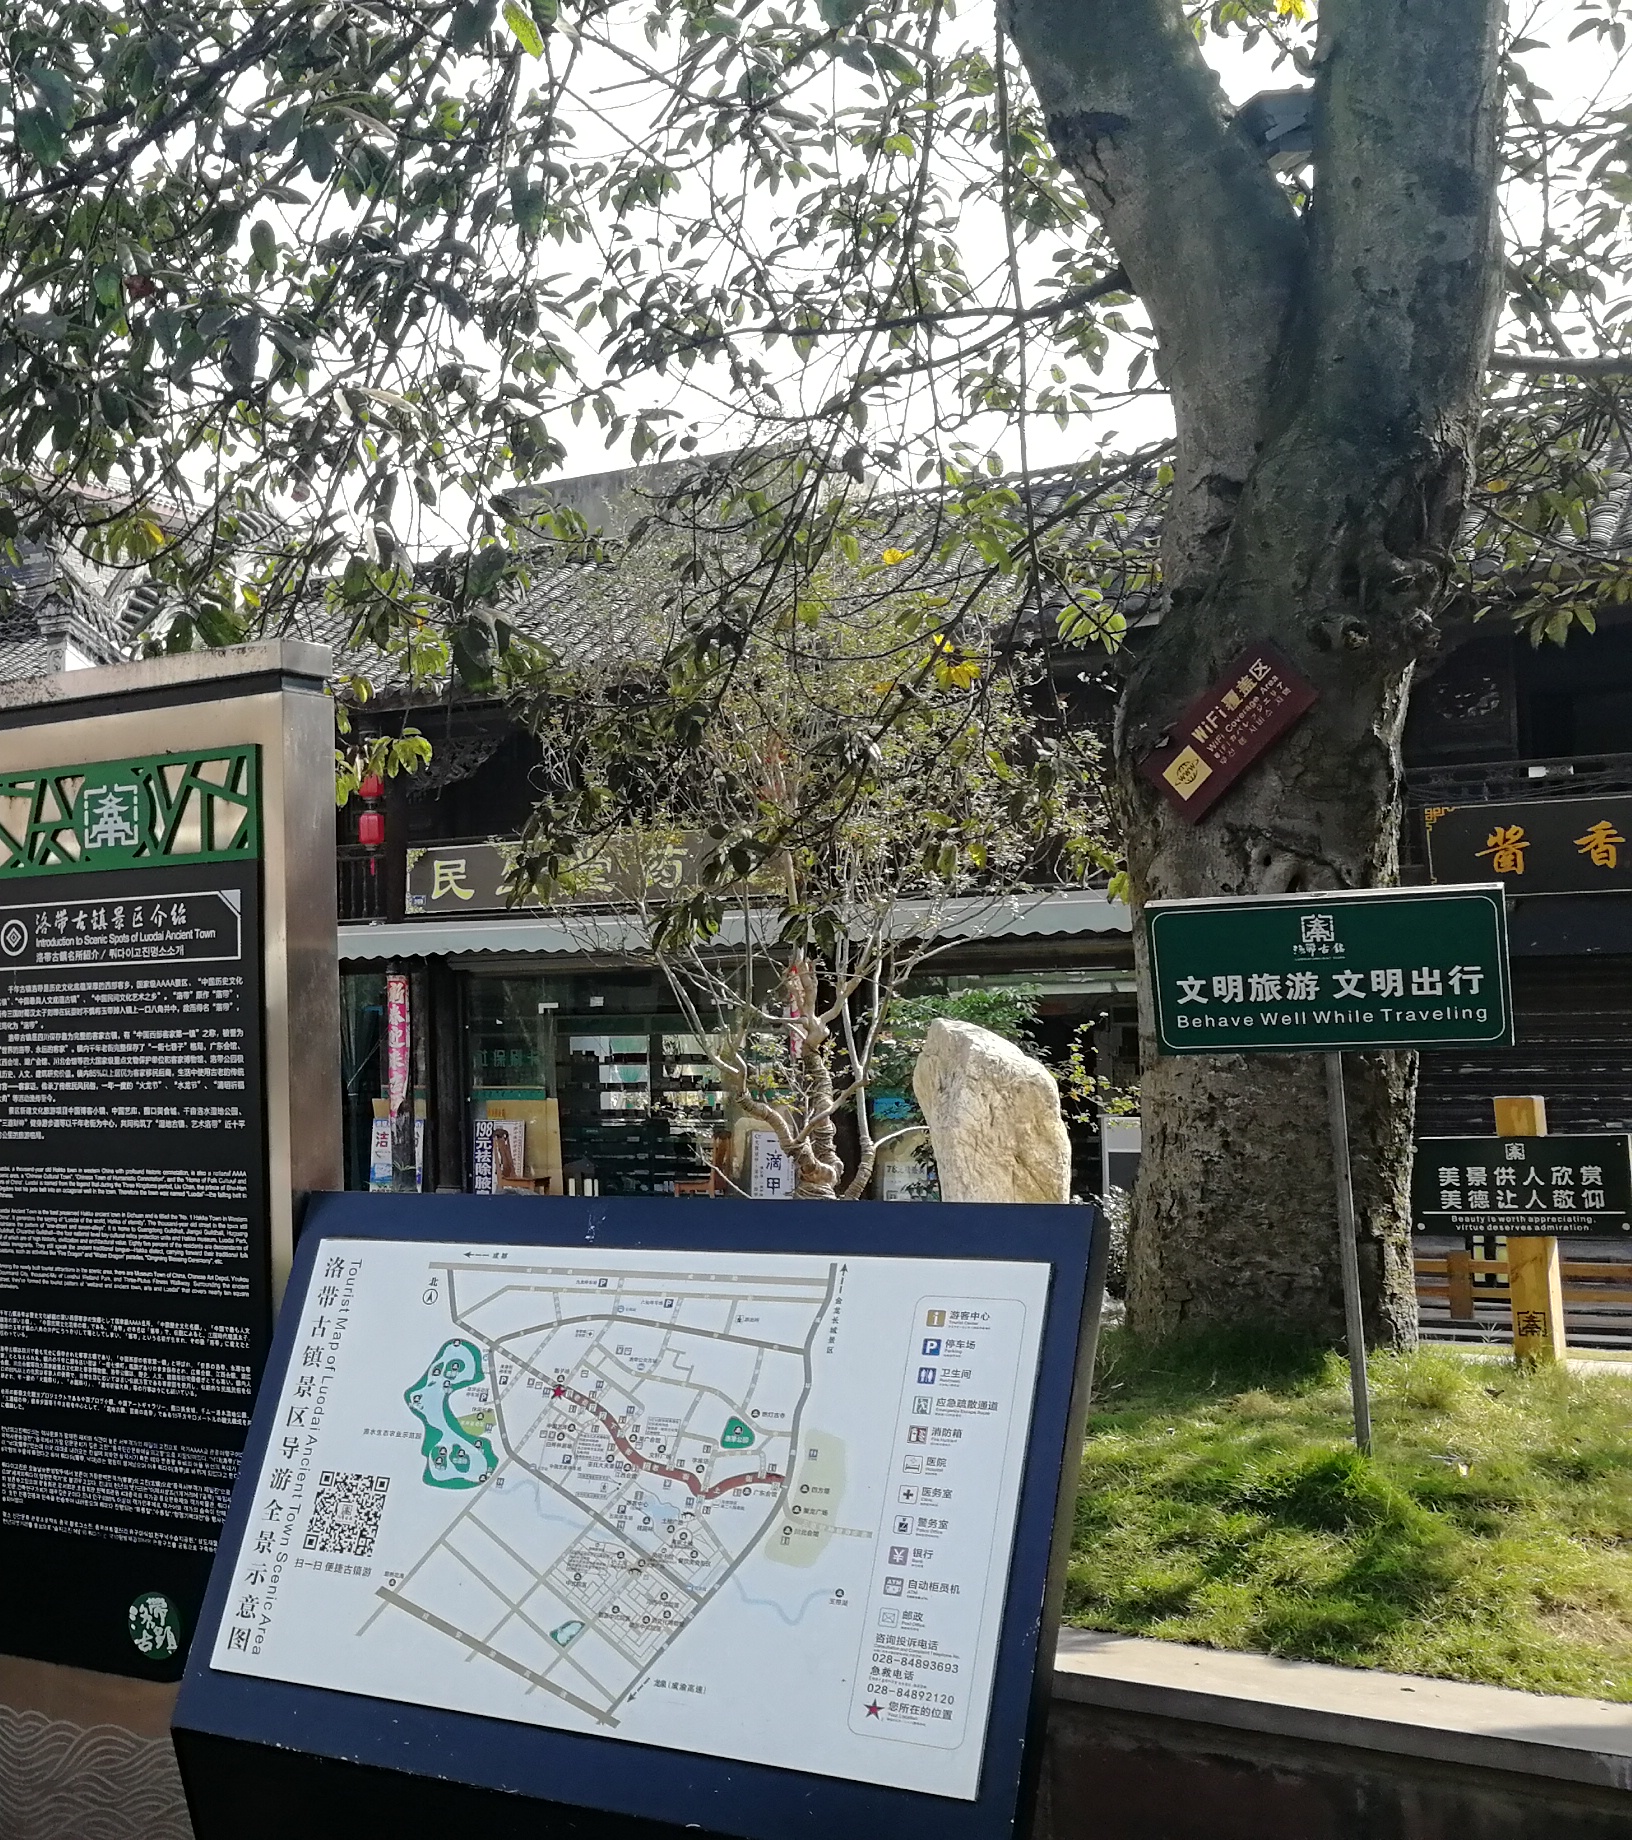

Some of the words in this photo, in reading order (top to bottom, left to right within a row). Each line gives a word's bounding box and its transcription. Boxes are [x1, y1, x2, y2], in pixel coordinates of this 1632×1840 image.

[1224, 695, 1260, 733] Coverage
[1259, 674, 1279, 695] Area
[35, 902, 187, 935] 洛带古镇景区介绍
[36, 936, 75, 948] Introduction
[84, 934, 108, 946] Scenic
[108, 933, 130, 945] Spots
[139, 931, 164, 943] Luodai
[165, 929, 193, 941] Ancient
[194, 928, 216, 939] Town
[1176, 971, 1320, 1005] 文明旅游
[1332, 965, 1485, 1000] 文明出行
[1177, 1014, 1255, 1030] Behave
[1260, 1011, 1307, 1026] Well
[1313, 1009, 1375, 1025] While
[1380, 1006, 1489, 1024] Traveling
[474, 1121, 494, 1195] 198元祛除腋
[1438, 1165, 1603, 1187] 美景供人欣赏
[1440, 1189, 1606, 1210] 美德让人敬仰
[1451, 1215, 1485, 1224] Beauty
[1487, 1215, 1497, 1223] is
[1498, 1215, 1526, 1223] worth
[1456, 1223, 1485, 1232] virtue
[1487, 1224, 1533, 1232] deserves
[338, 1258, 362, 1313] Tourist
[429, 1277, 438, 1287] 北
[949, 1311, 990, 1322] 游客中心
[328, 1317, 349, 1351] Map
[945, 1339, 976, 1350] 停车场
[324, 1355, 336, 1372] of
[940, 1368, 972, 1379] 卫生间
[310, 1375, 334, 1431] Luodai
[936, 1397, 998, 1412] 应急疏散通道
[931, 1427, 963, 1438] 消防箱
[227, 1256, 345, 1651] 洛带古镇景区导游全景示意图
[926, 1457, 947, 1467] 医院
[292, 1434, 319, 1499] Ancient
[921, 1486, 953, 1499] 医务室
[279, 1503, 302, 1546] Town
[918, 1517, 949, 1530] 警务室
[912, 1548, 934, 1560] 银行
[294, 1557, 322, 1573] 扫一扫
[324, 1559, 373, 1577] 便捷古镇游
[263, 1551, 289, 1611] Scenic
[908, 1579, 960, 1595] 自动柜员机
[902, 1610, 924, 1622] 邮政
[252, 1613, 272, 1655] Area
[876, 1633, 939, 1650] 咨询投诉电话
[870, 1665, 914, 1681] 急救电话
[872, 1653, 959, 1674] 028-84893693
[867, 1683, 955, 1705] 028-84892120
[888, 1701, 953, 1720] 您所在的位置
